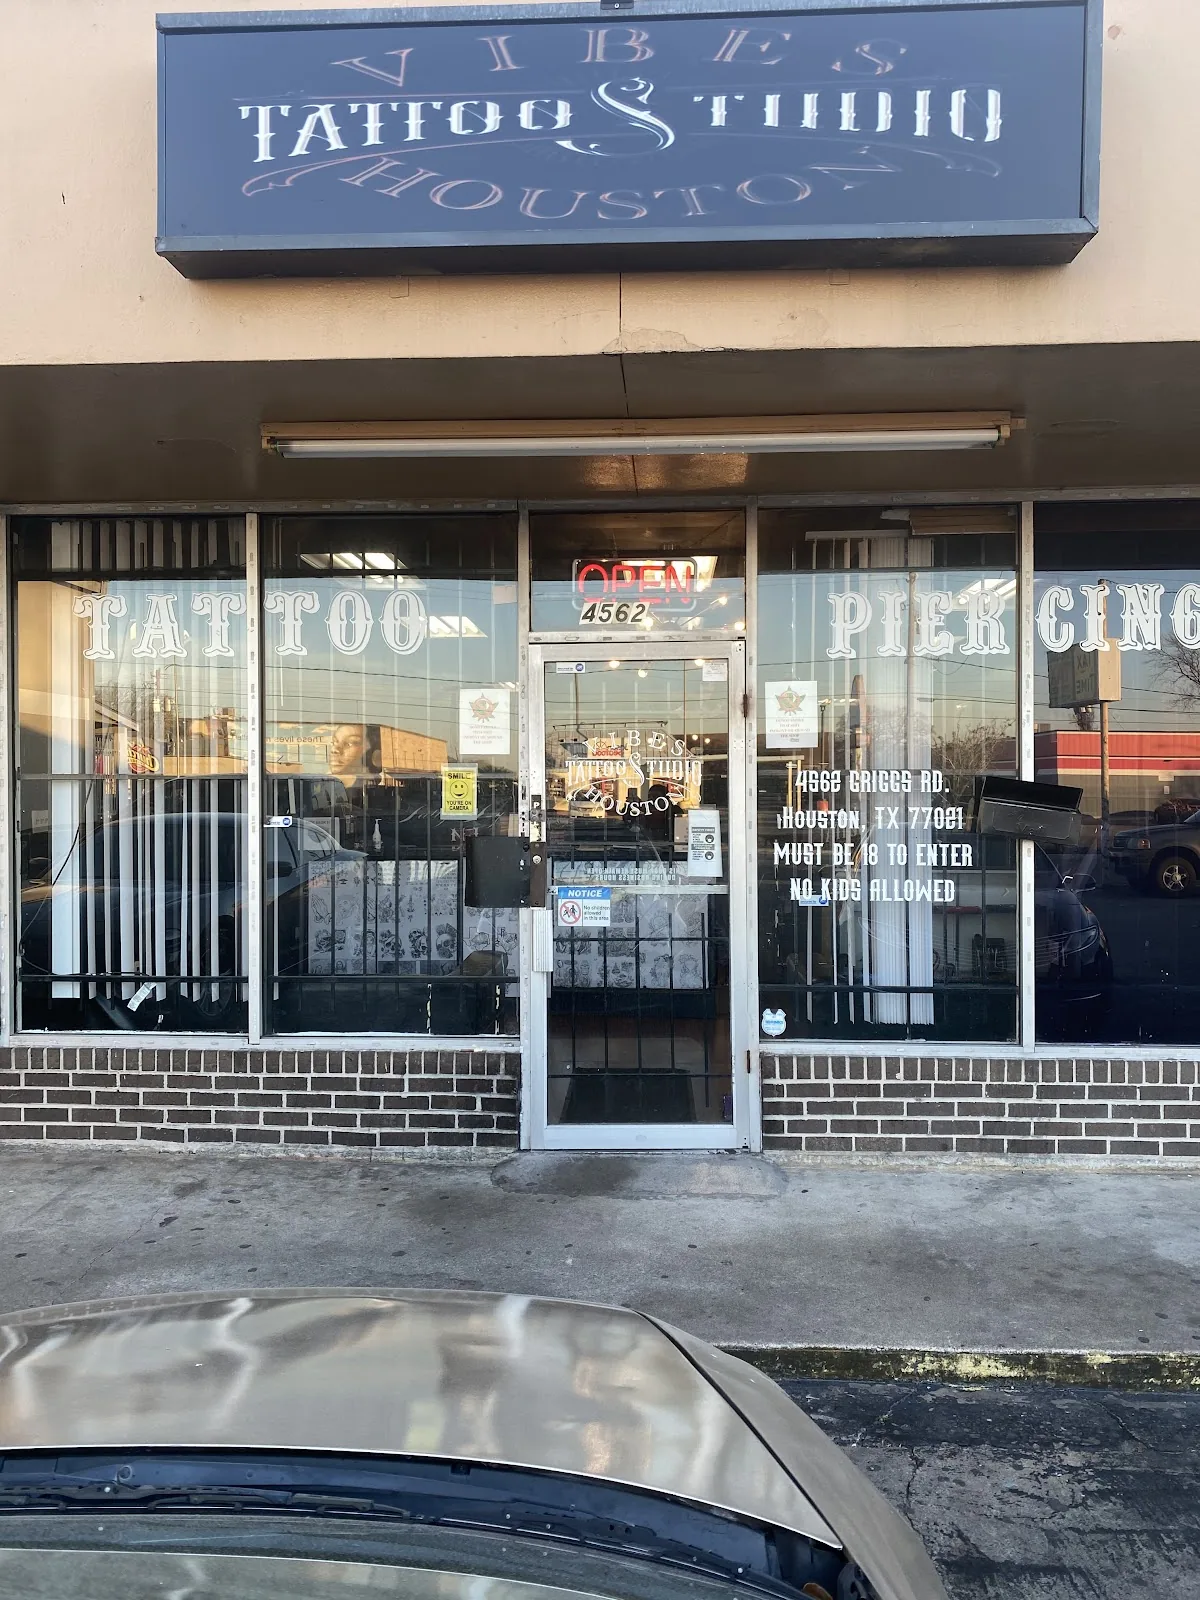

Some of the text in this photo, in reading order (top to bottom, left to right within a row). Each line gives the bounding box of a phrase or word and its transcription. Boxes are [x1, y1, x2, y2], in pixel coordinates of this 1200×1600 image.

[331, 28, 908, 87] VIBES
[237, 77, 1002, 163] TATTOO STUDIO
[340, 146, 902, 220] HOUSTON
[577, 563, 693, 603] OPEN
[580, 603, 647, 623] 4562
[583, 730, 686, 756] VIBES
[447, 772, 472, 780] SMILE
[565, 752, 703, 788] TATTOO STUDIO
[795, 770, 950, 793] 4562 GRIGGS RD.
[584, 784, 685, 816] HOUSTON
[782, 806, 964, 832] HOUSTON, TX 77021
[773, 842, 973, 867] MUST BE 18 TO ENTER
[567, 889, 603, 898] NOTICE
[789, 878, 955, 902] NO KIDS ALLOWED
